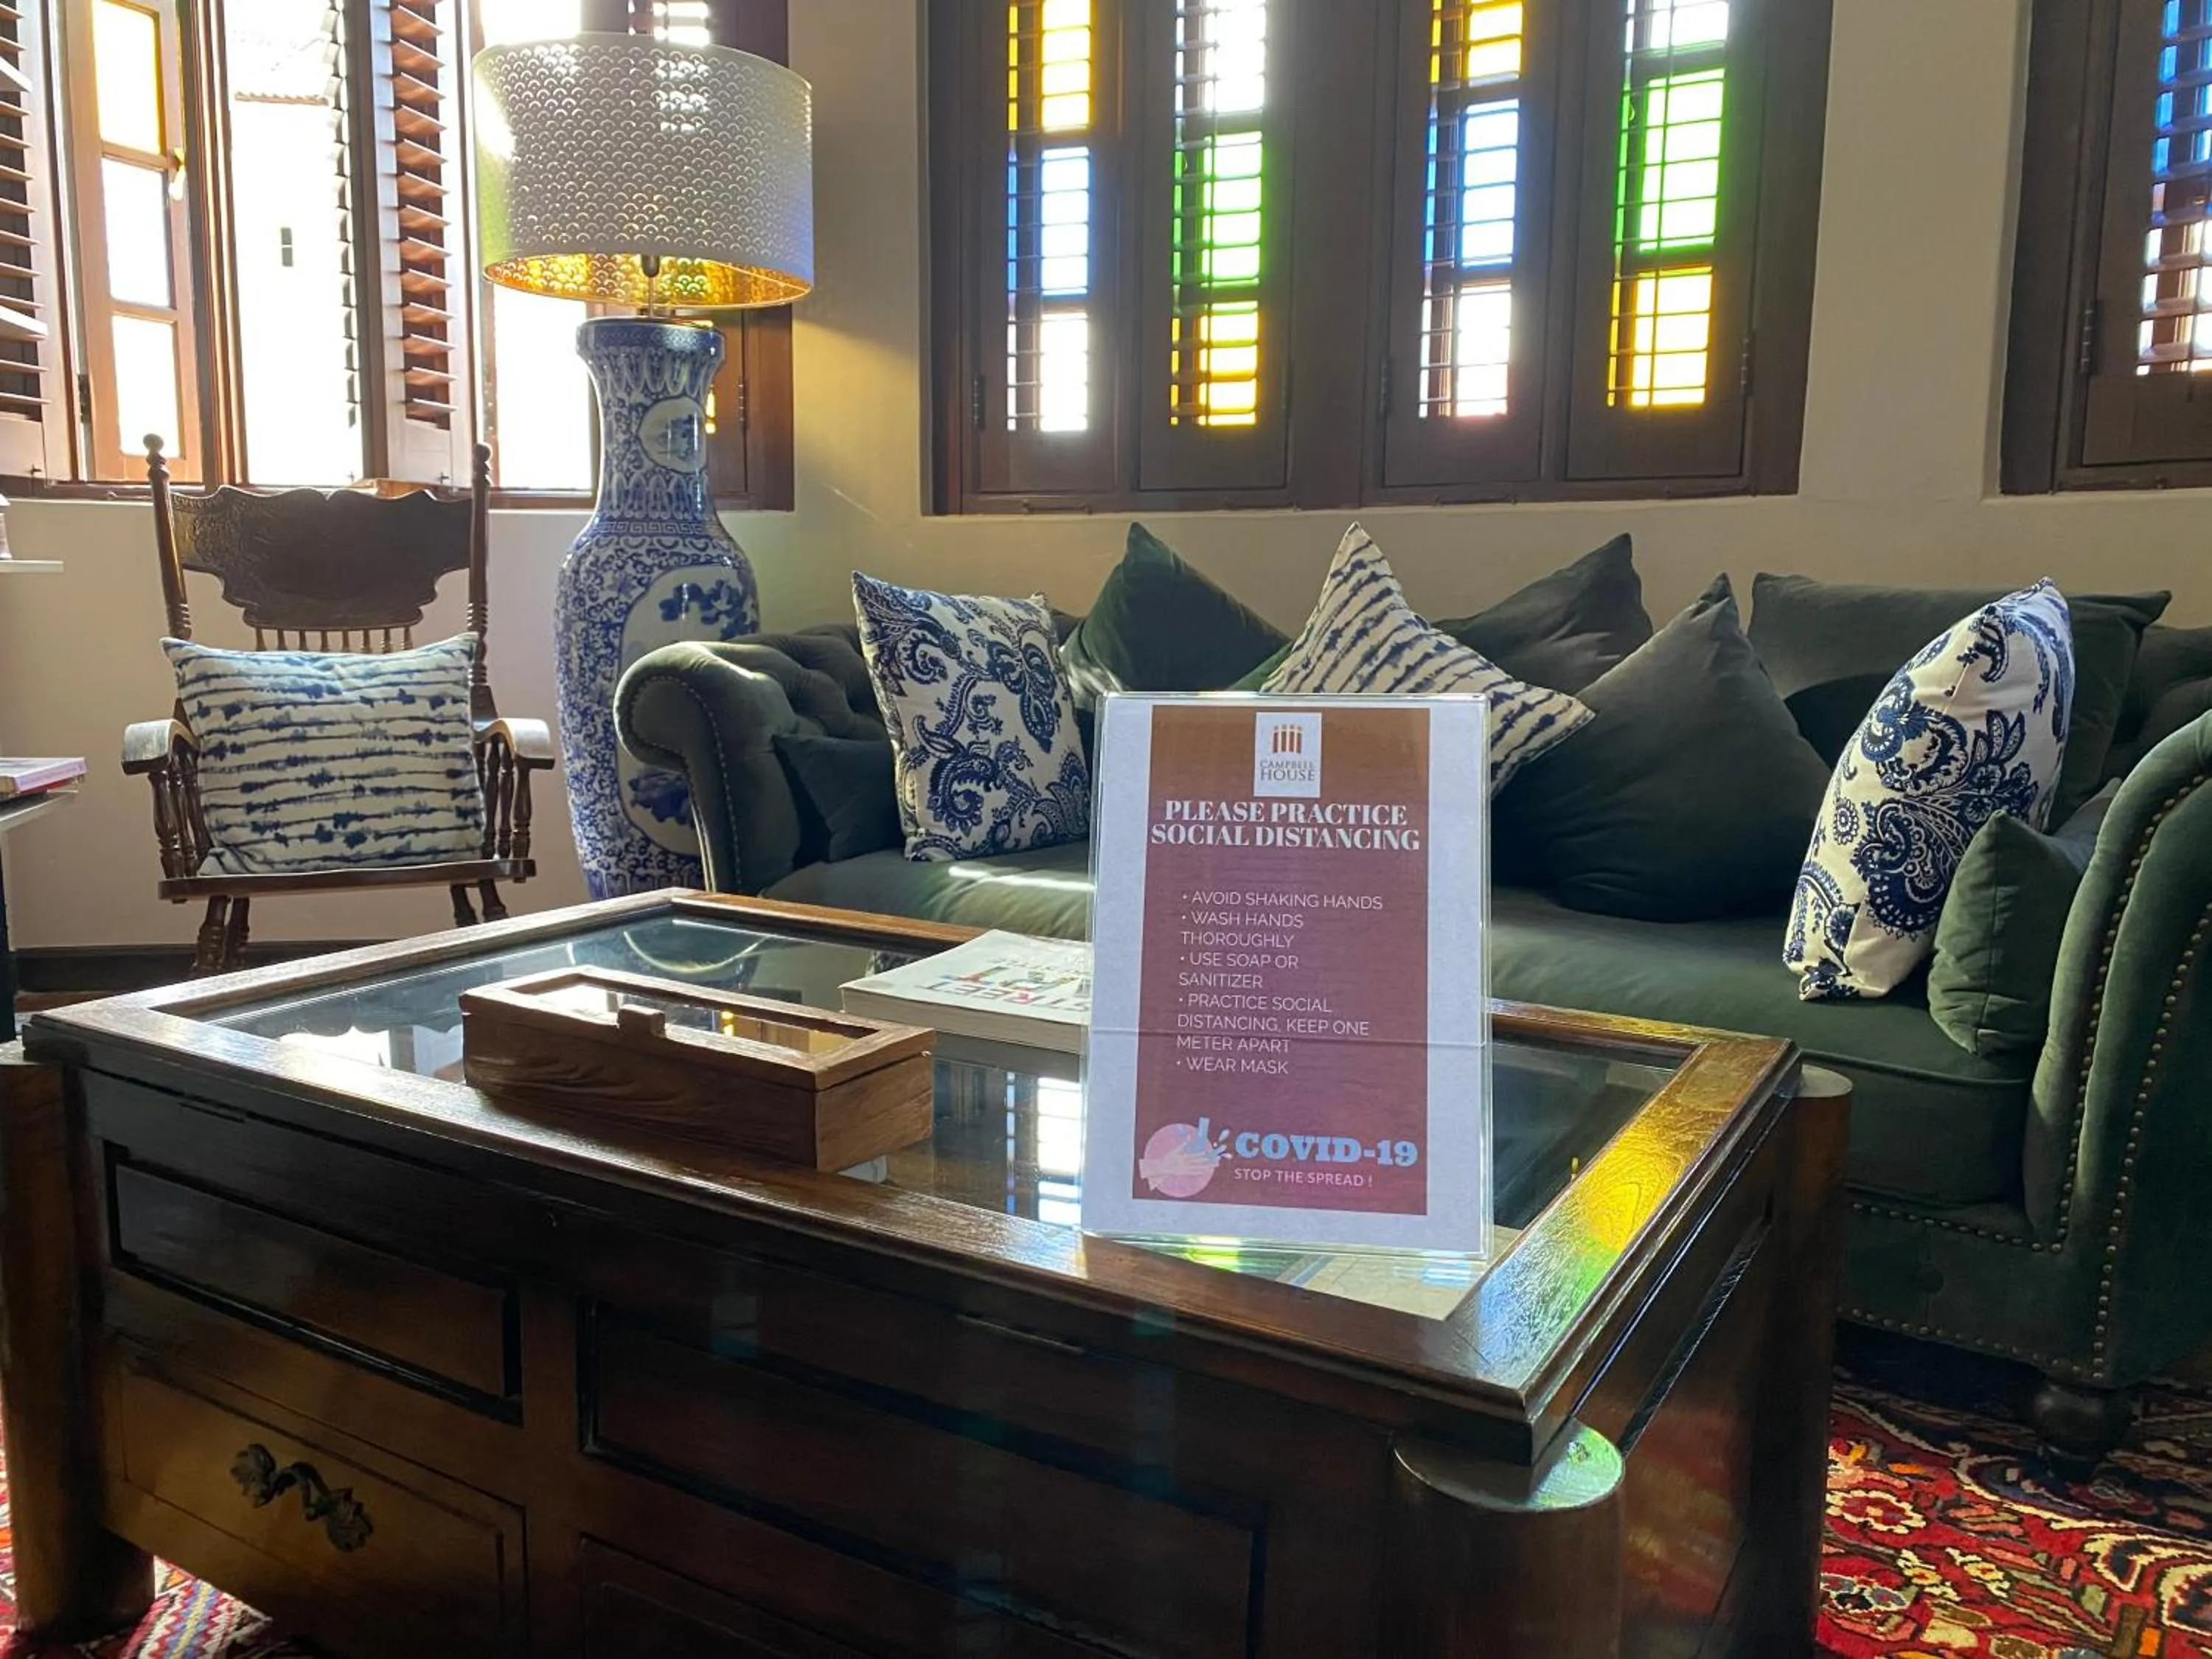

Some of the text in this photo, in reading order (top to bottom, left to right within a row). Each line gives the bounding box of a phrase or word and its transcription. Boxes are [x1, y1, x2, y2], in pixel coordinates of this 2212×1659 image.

[1261, 769, 1315, 782] HOUSE
[1165, 801, 1408, 825] PLEASE PRACTICE
[1151, 824, 1419, 850] SOCIAL DISTANCING
[1192, 891, 1382, 909] AVOID SHAKING HANDS
[1191, 912, 1304, 928] WASH HANDS
[1181, 932, 1294, 947] THOROUGHLY
[1190, 953, 1298, 969] USE SOAP OR
[1179, 973, 1262, 988] SANITIZER
[1189, 994, 1332, 1012] PRACTICE SOCIAL
[1287, 1018, 1329, 1033] KEEP
[1333, 1020, 1369, 1035] ONE
[1178, 1035, 1291, 1053] METER APART
[1187, 1056, 1288, 1074] WEAR MASK
[1235, 1131, 1418, 1166] COVID-19
[1234, 1168, 1270, 1181] STOP
[1276, 1170, 1304, 1183] THE
[1308, 1171, 1363, 1186] SPREAD
